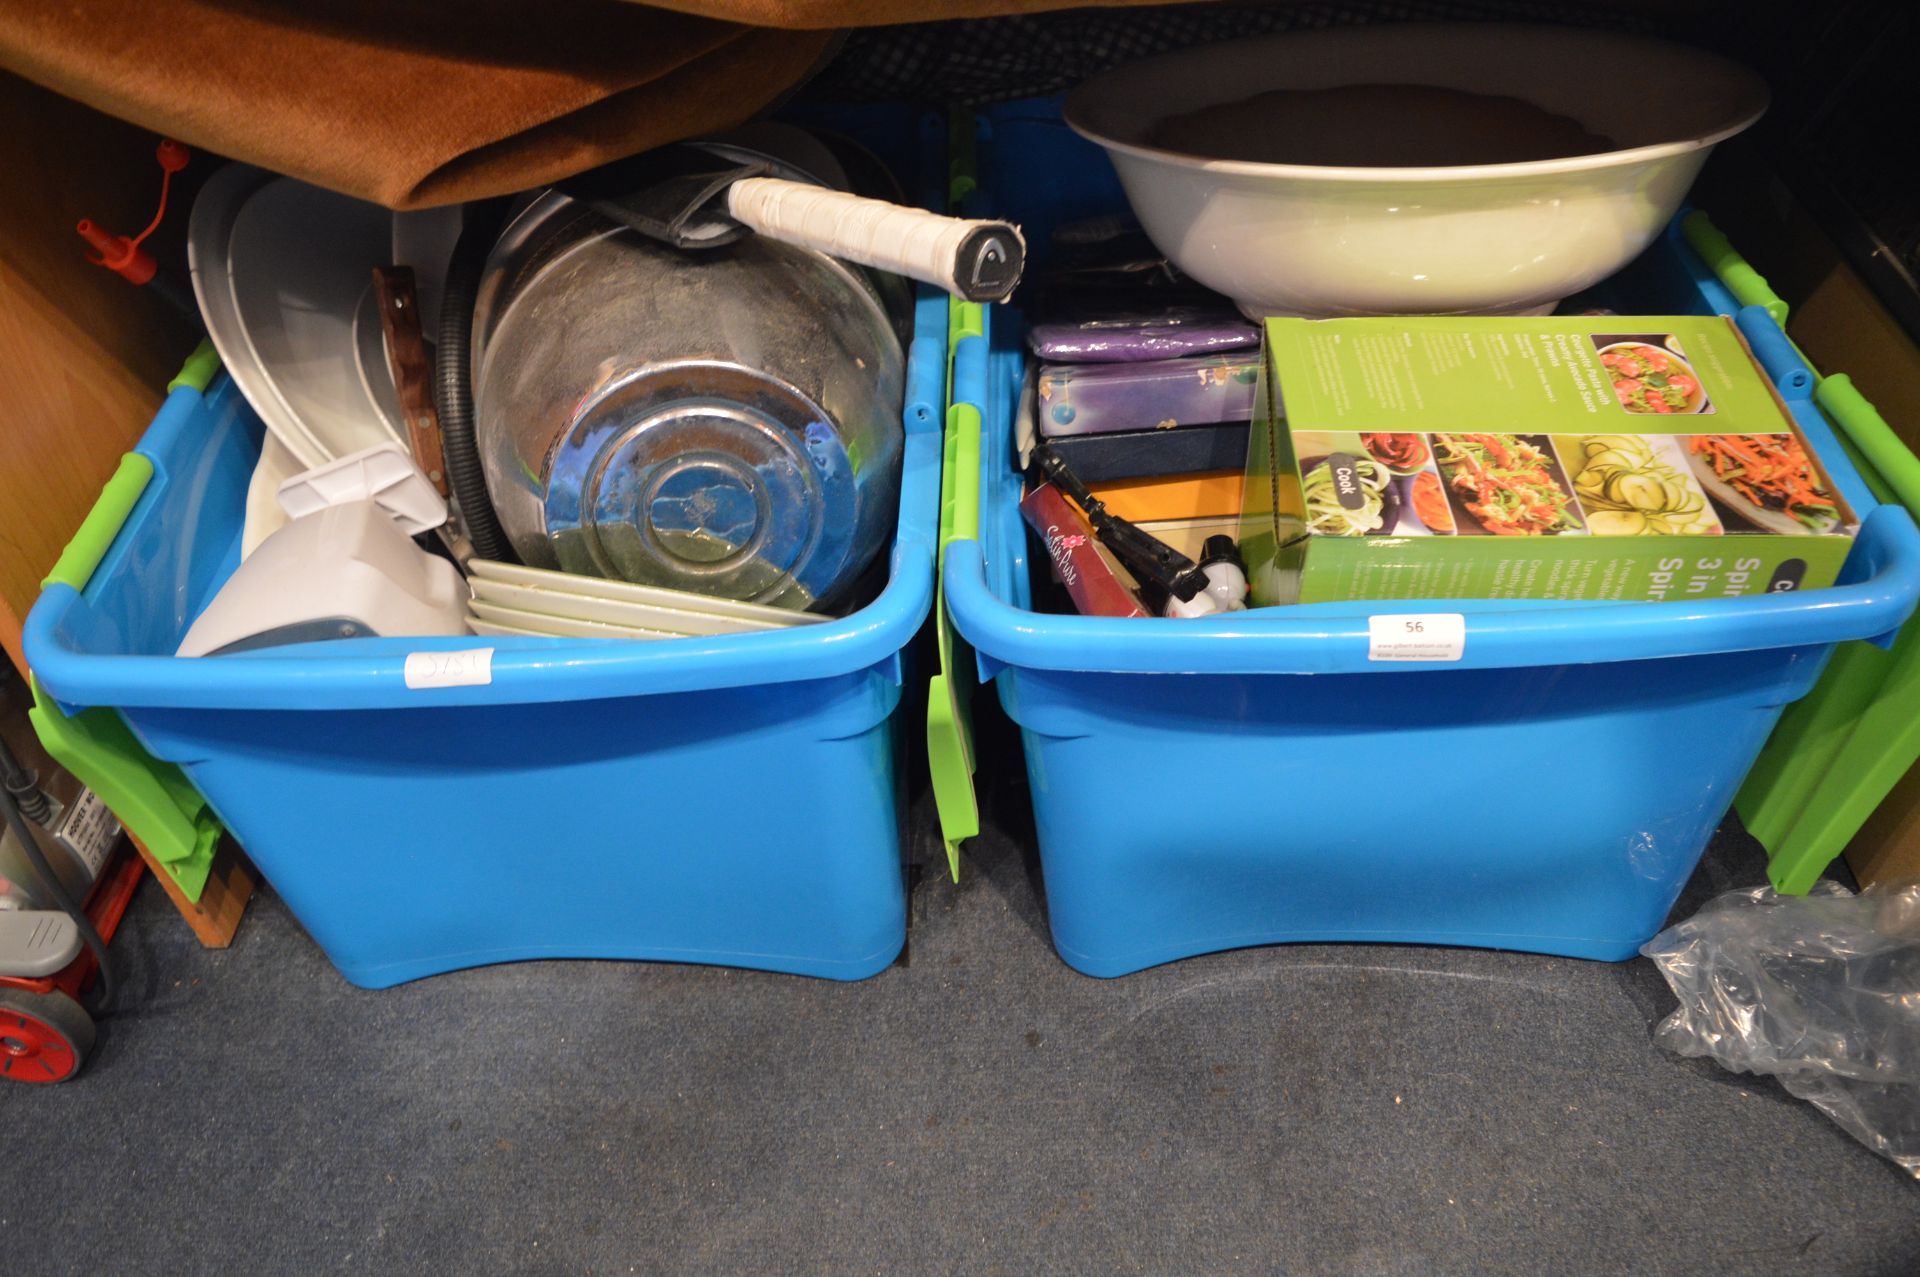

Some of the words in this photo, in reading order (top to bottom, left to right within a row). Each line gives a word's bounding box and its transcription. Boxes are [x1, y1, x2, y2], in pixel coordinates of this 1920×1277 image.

[1541, 341, 1561, 368] Prawns
[1554, 334, 1572, 361] Creamy
[1567, 361, 1588, 391] Avocado
[1580, 391, 1597, 413] Sauce
[1570, 334, 1593, 369] Courgette
[1586, 368, 1603, 389] Pasta
[1596, 388, 1611, 405] with
[1336, 467, 1357, 495] Cook
[1696, 558, 1723, 570] 3
[1645, 558, 1683, 602] Spir
[1686, 575, 1717, 593] in
[1406, 621, 1424, 633] 56
